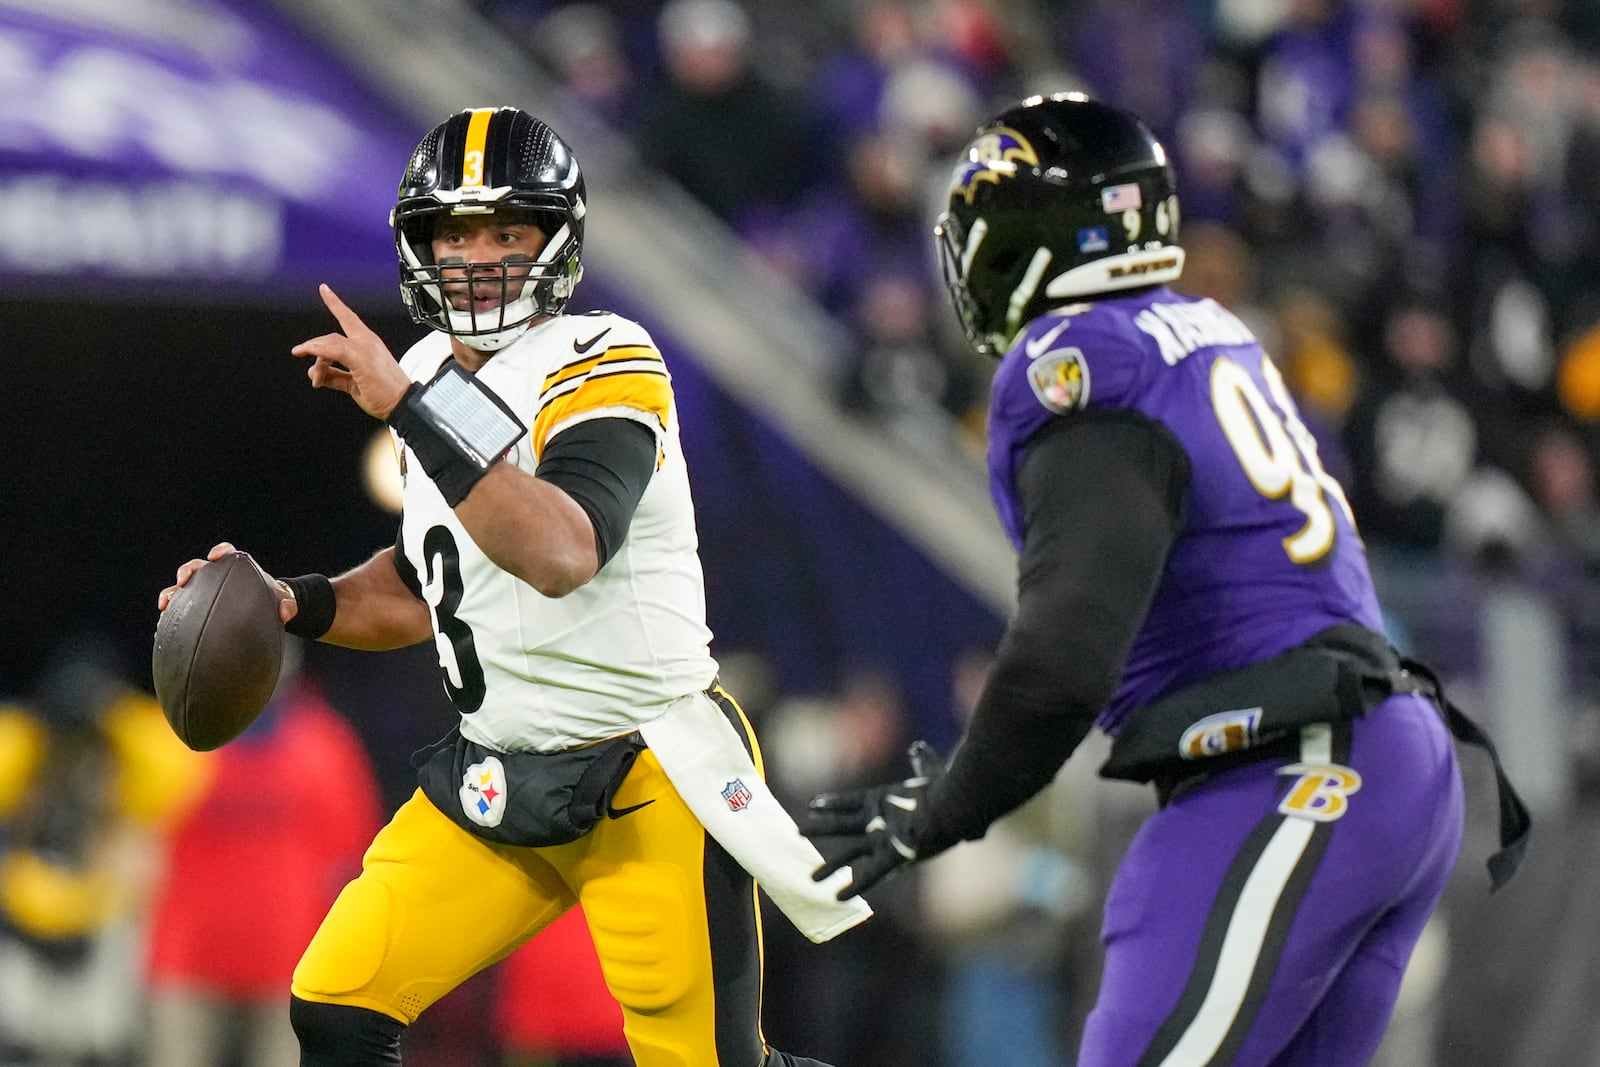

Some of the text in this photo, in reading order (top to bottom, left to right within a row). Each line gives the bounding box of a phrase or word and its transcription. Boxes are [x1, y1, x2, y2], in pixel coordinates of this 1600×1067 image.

[465, 151, 483, 186] 3
[423, 524, 487, 714] 3
[728, 788, 750, 810] NFL
[1274, 762, 1362, 822] B
